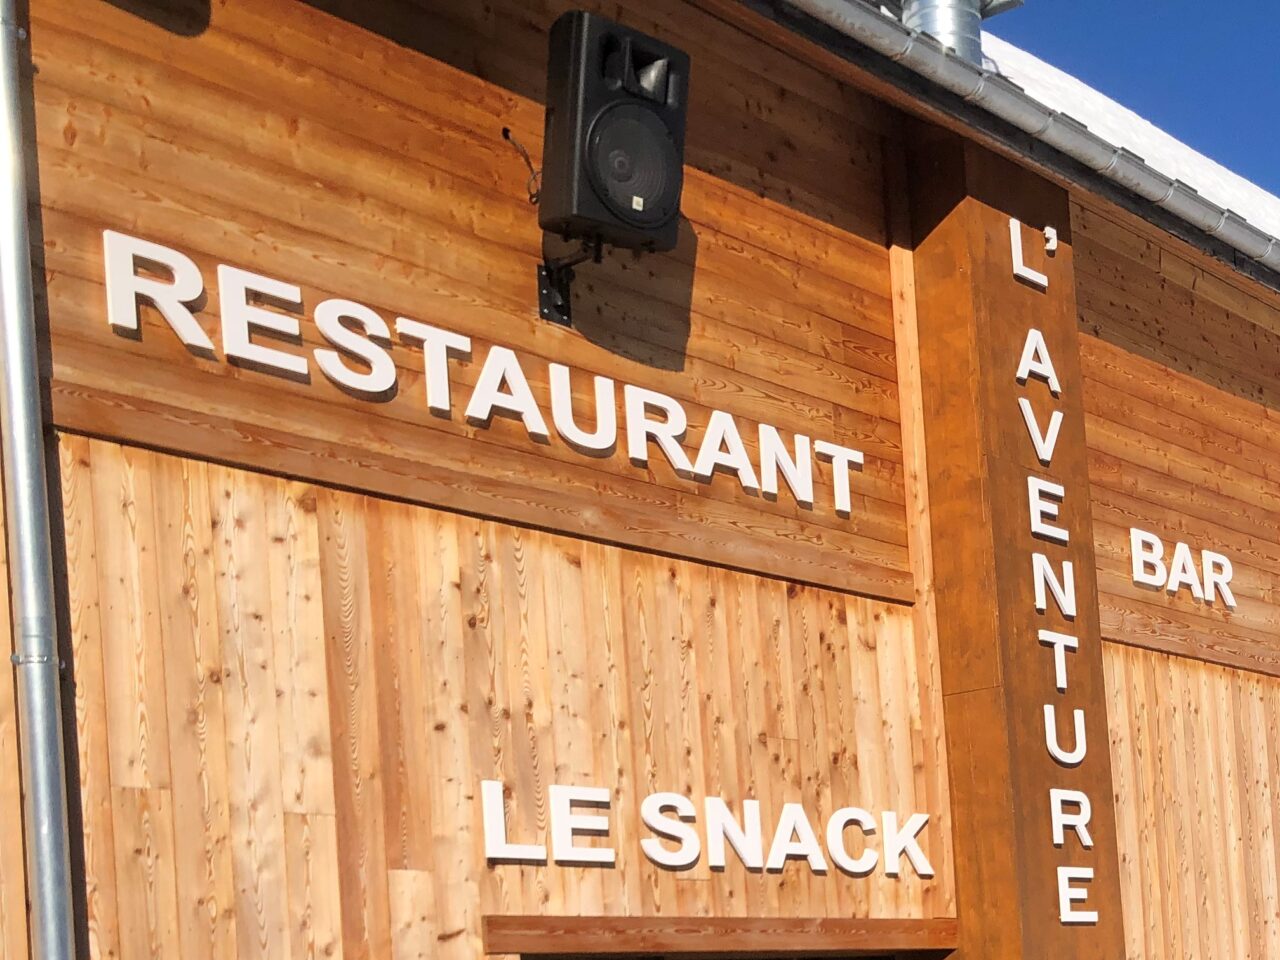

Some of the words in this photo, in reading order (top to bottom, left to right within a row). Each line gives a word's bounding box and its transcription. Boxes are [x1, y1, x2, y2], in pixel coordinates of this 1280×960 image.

[103, 229, 864, 513] RESTAURANT
[1009, 218, 1099, 923] L'AVENTURE
[1130, 527, 1237, 608] BAR
[481, 780, 616, 863] LE
[640, 792, 936, 877] SNACK
